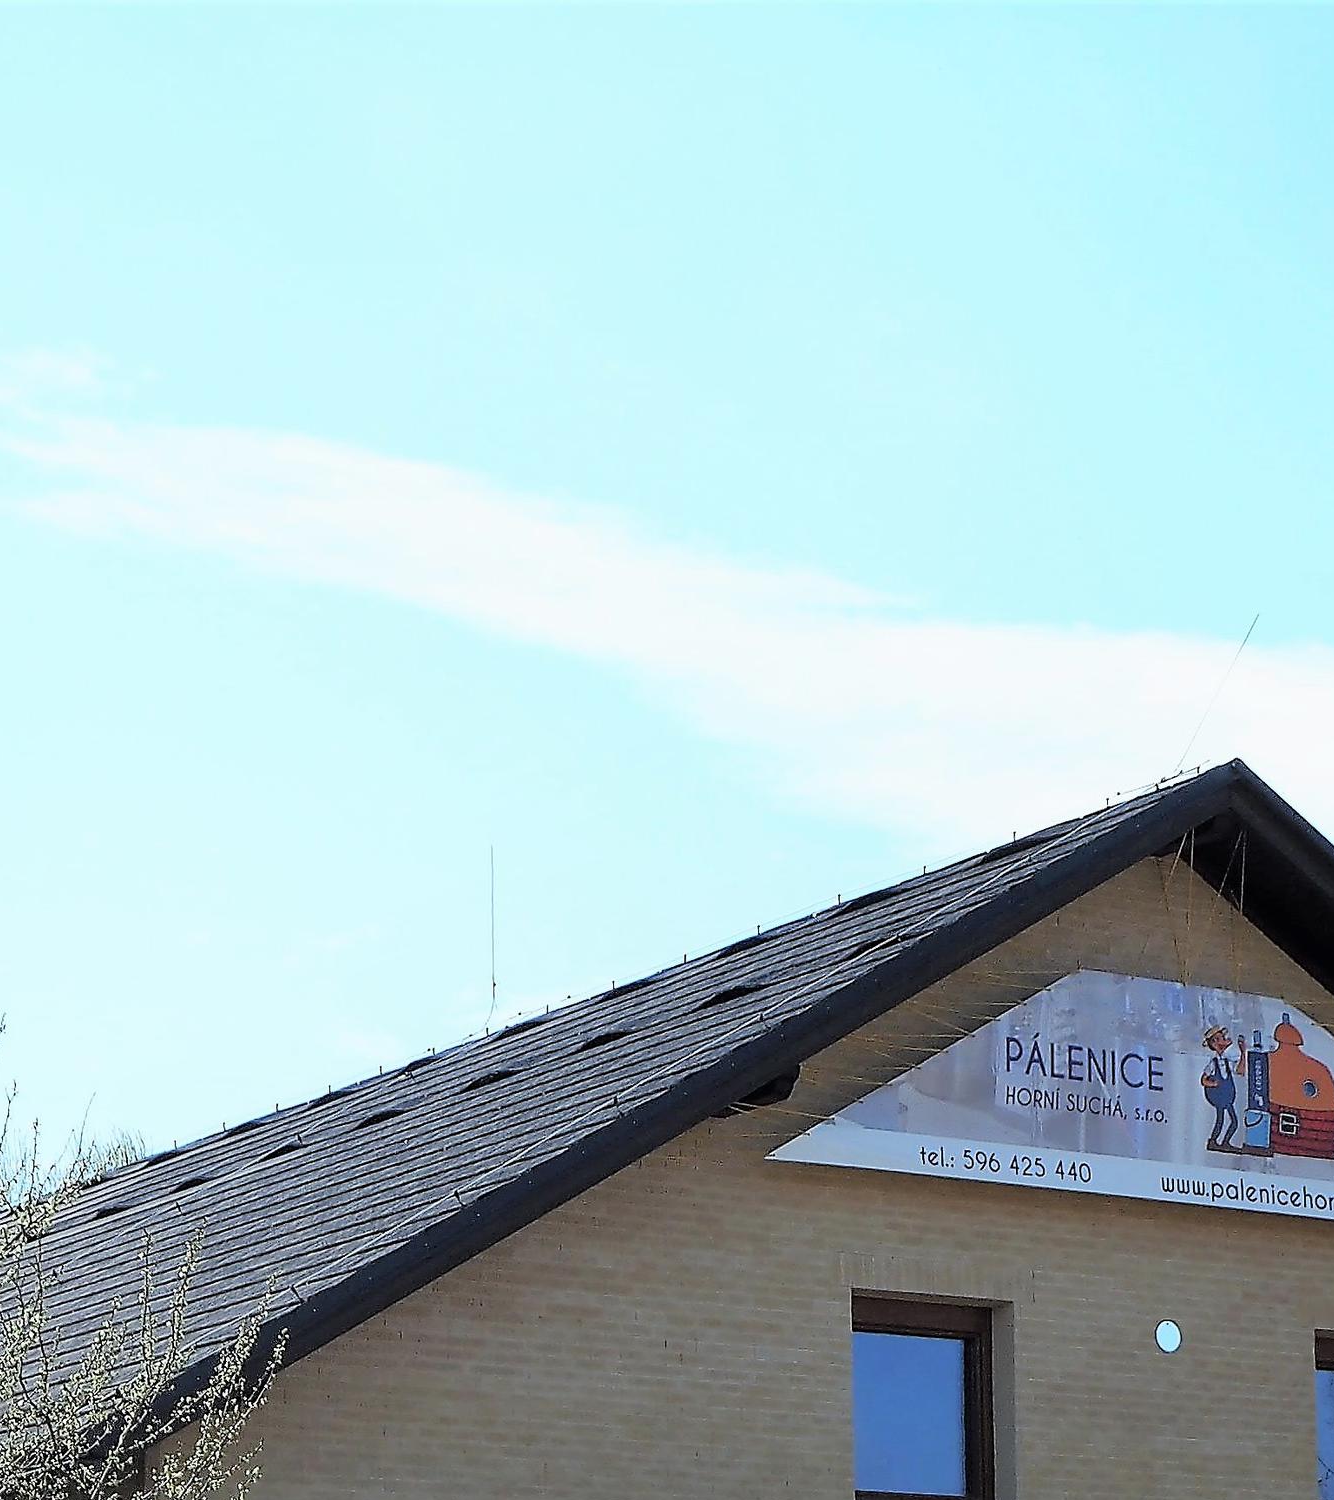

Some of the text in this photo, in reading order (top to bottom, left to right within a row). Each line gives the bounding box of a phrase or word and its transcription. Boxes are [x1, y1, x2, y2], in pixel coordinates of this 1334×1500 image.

[1005, 1032, 1164, 1092] PÁLENICE
[1005, 1085, 1168, 1124] HORNÍ SUCHÁ, s.r.o.
[919, 1146, 1092, 1183] tel.: 596 425 440
